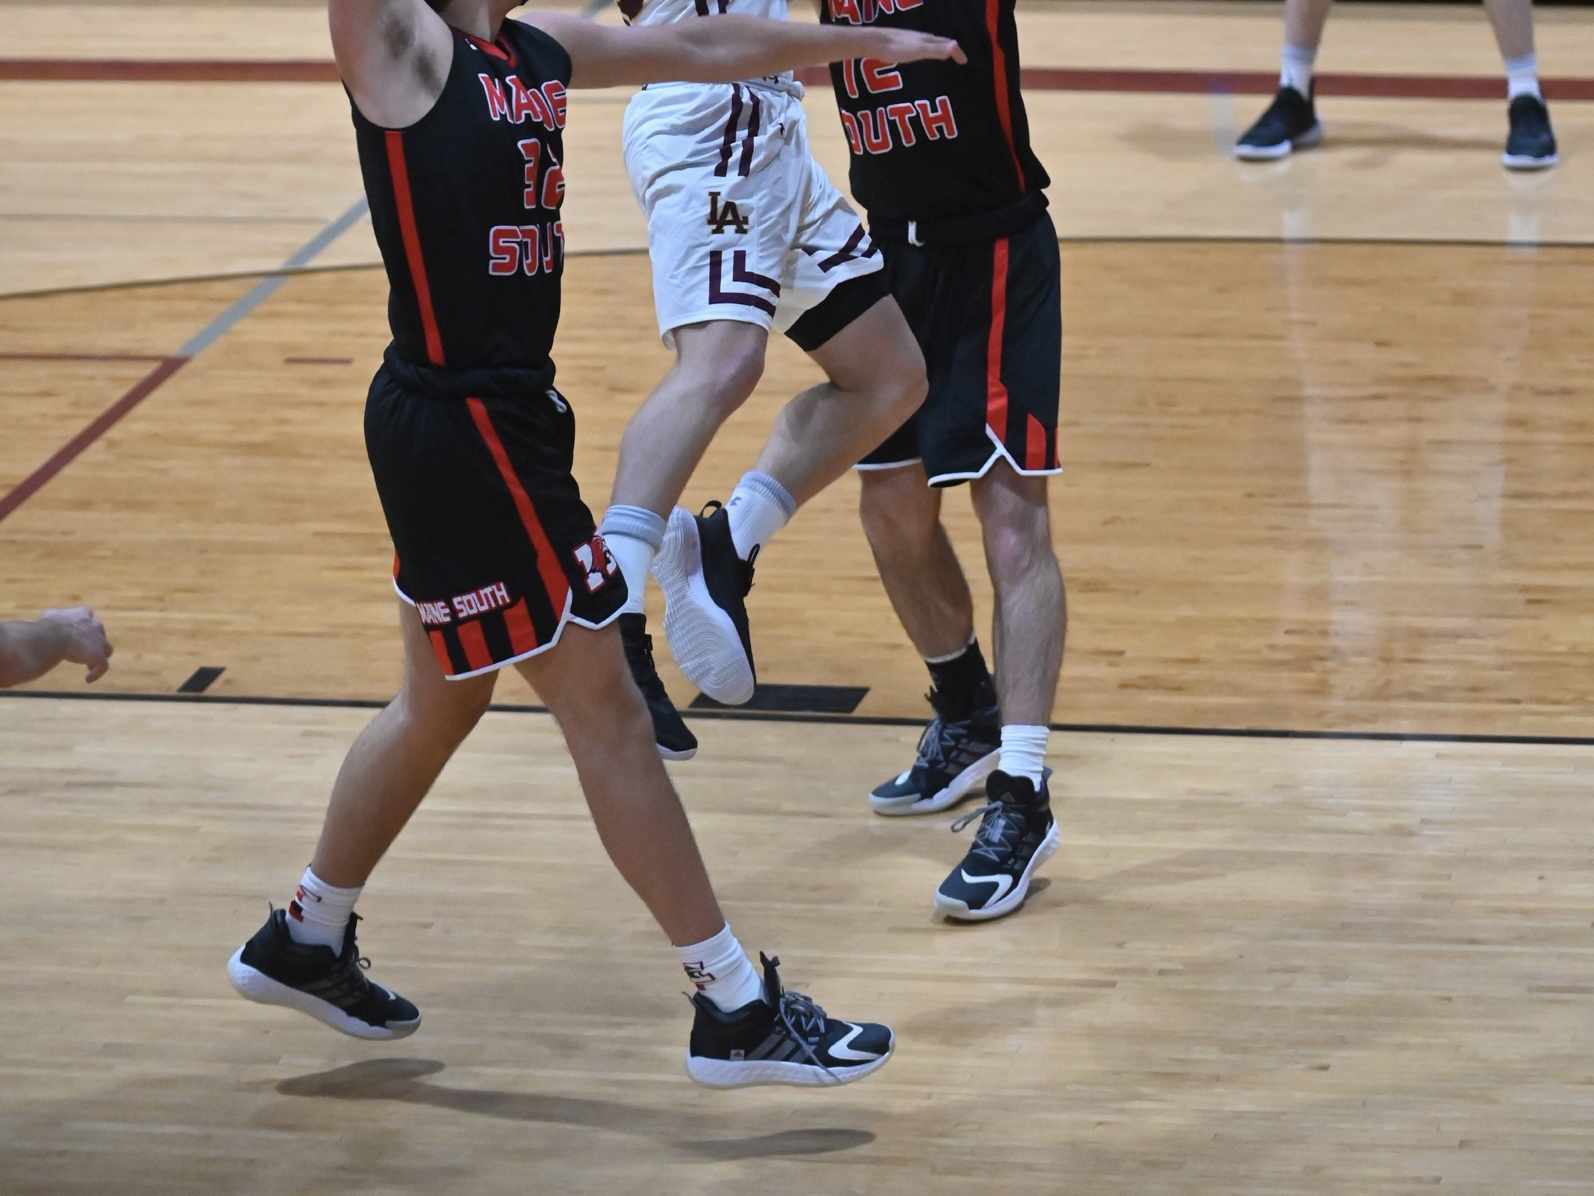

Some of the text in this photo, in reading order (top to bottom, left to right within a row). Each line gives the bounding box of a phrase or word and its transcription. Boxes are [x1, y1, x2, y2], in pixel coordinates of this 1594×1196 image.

[478, 73, 567, 131] MAE
[841, 95, 958, 155] OUTH
[517, 138, 566, 209] 32
[707, 191, 749, 234] LA
[452, 581, 511, 619] SOUTH
